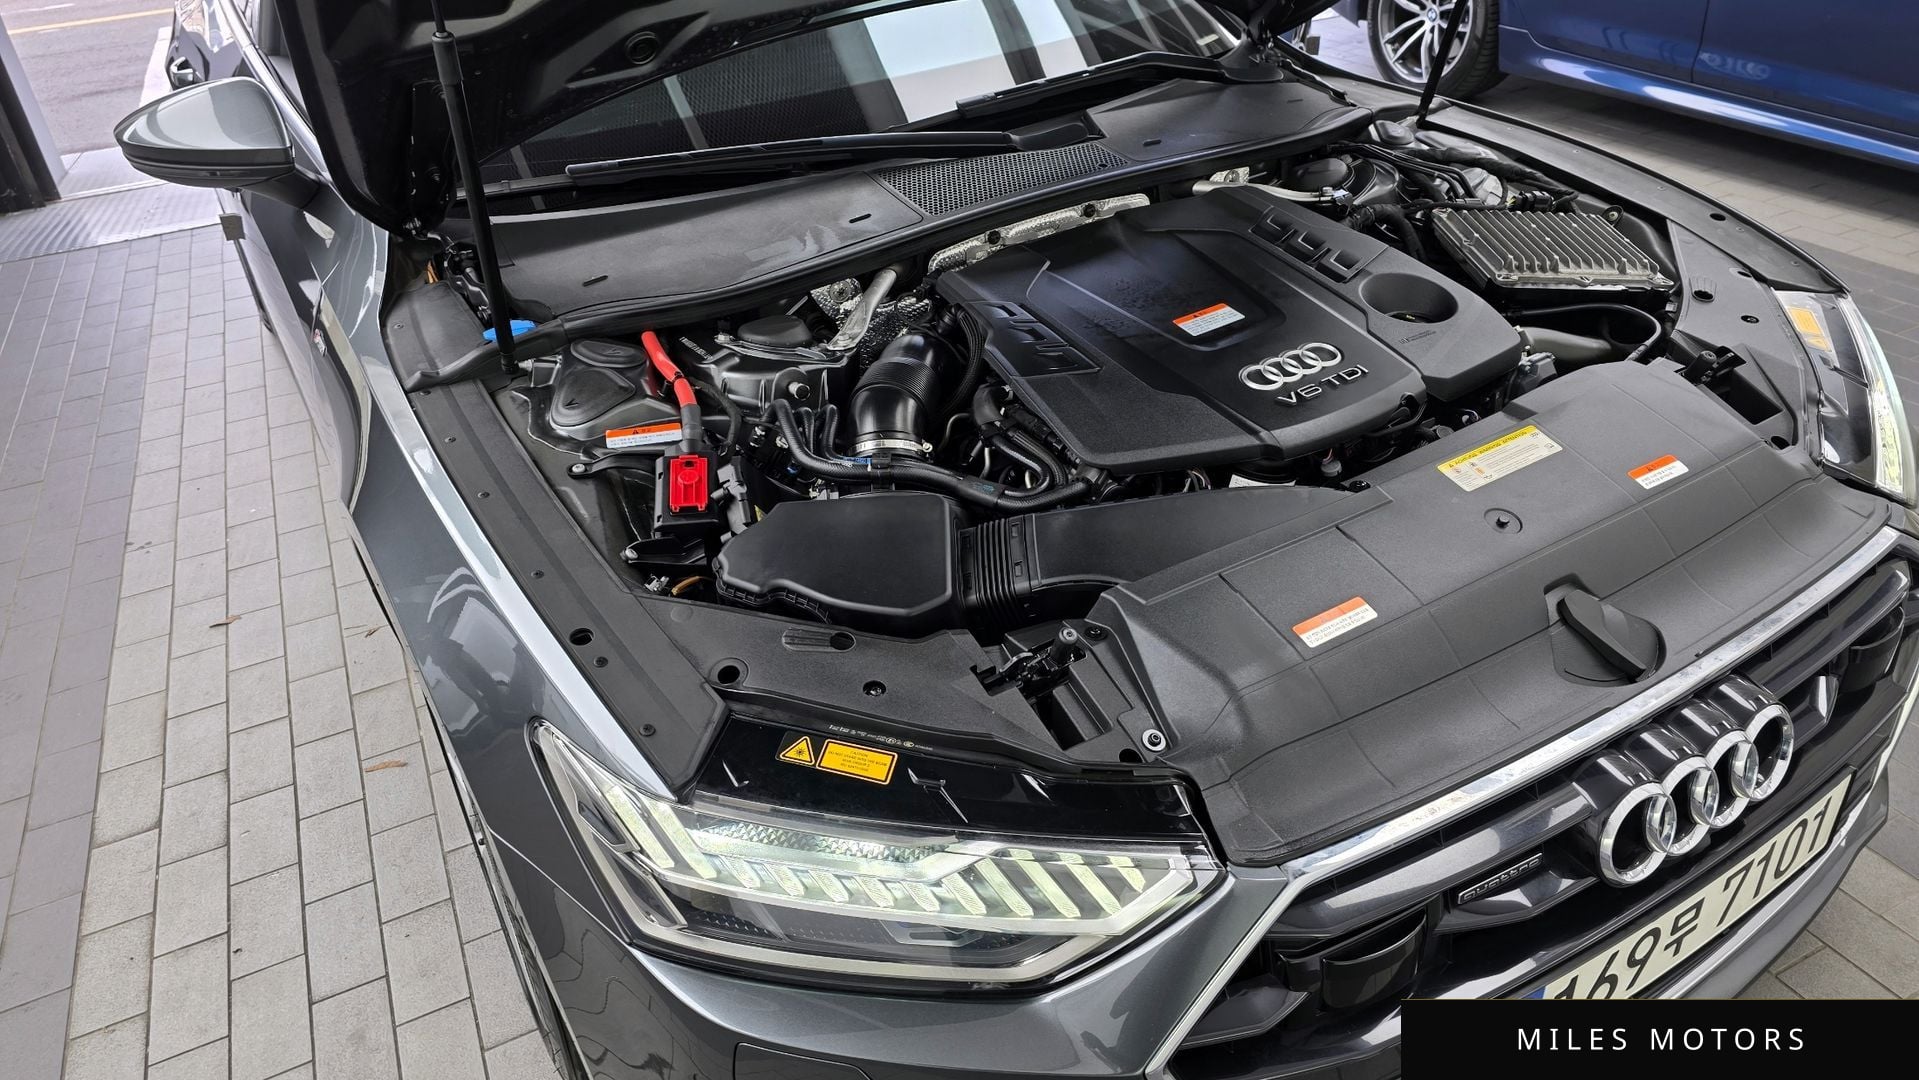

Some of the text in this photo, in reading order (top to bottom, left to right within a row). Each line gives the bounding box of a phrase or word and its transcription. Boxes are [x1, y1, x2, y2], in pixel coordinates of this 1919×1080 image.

[1275, 364, 1369, 406] V6 TDI
[1463, 858, 1540, 901] quattro
[1716, 795, 1833, 928] 7101
